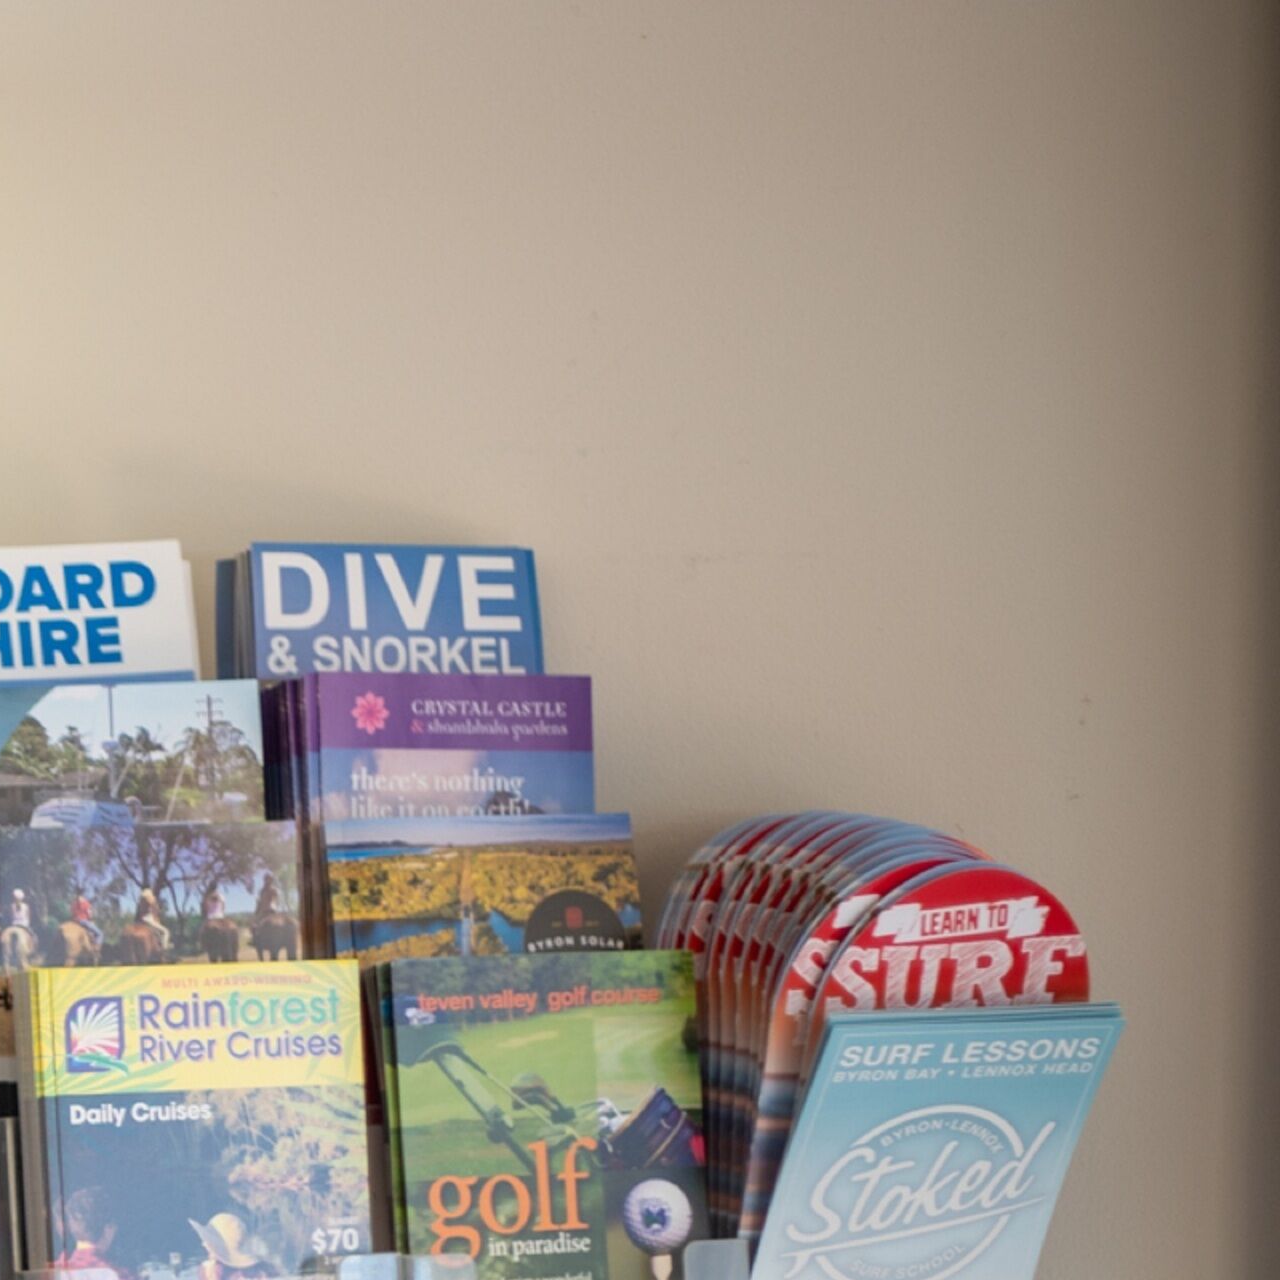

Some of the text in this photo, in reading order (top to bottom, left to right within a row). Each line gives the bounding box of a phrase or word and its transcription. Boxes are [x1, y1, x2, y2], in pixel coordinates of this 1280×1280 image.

[260, 550, 523, 632] DIVE
[267, 635, 527, 675] & SNORKEL
[410, 700, 567, 718] CRYSTAL CASTLE
[411, 719, 424, 734] &
[511, 719, 568, 741] gardens
[350, 766, 525, 798] there's nothing
[350, 796, 392, 818] like
[921, 903, 1009, 937] LEARN TO
[162, 976, 200, 990] MULTI
[825, 935, 1087, 1010] SURF
[139, 988, 341, 1030] Rainforest
[417, 986, 662, 1013] teven valley golf course
[139, 1031, 342, 1063] River Cruises
[841, 1038, 1101, 1068] SURF LESSONS
[833, 1061, 1093, 1083] BYRON BAY LENNOX HEAD
[69, 1102, 213, 1128] Daily Cruises
[786, 1121, 1056, 1243] Stoked
[428, 1138, 597, 1268] golf
[311, 1226, 360, 1255] $70
[489, 1232, 592, 1262] in paradise
[848, 1243, 969, 1280] SURF SCHOOL
